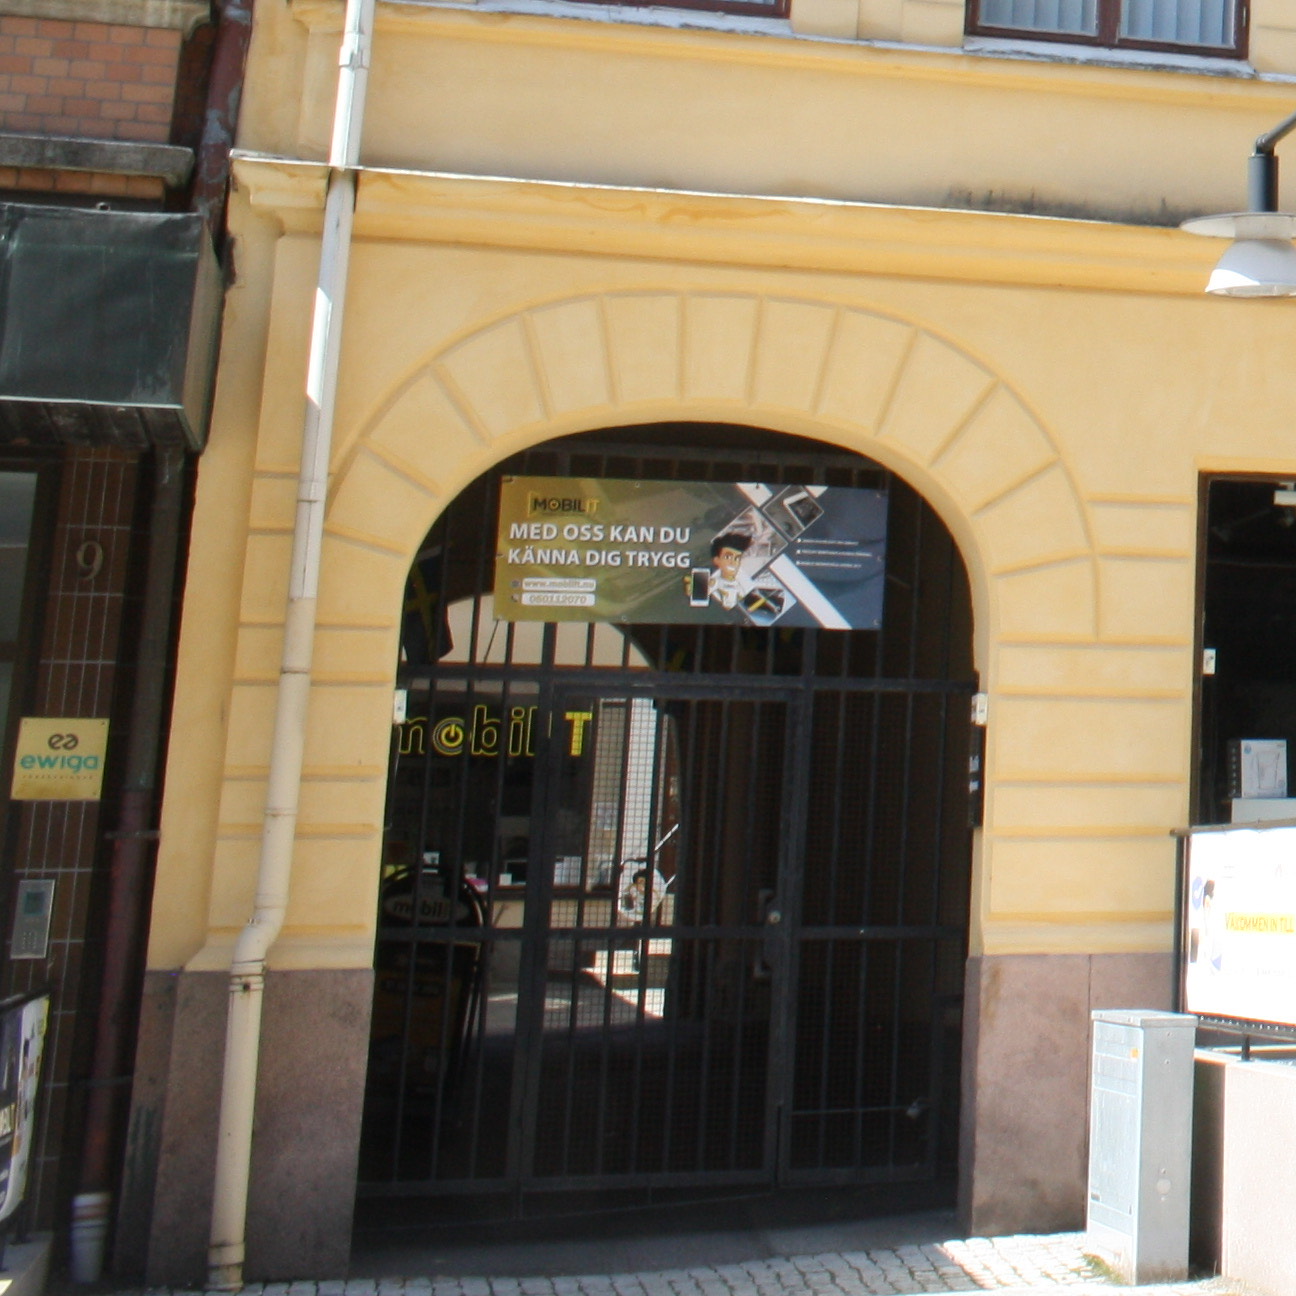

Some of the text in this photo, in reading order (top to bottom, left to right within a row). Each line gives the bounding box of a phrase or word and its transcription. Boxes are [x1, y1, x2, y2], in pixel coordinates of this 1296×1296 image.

[510, 522, 691, 544] MED OSS KAN DU
[76, 541, 103, 581] 9
[507, 545, 691, 568] KÄNNA DIG TRYGG
[20, 754, 100, 775] ewiga
